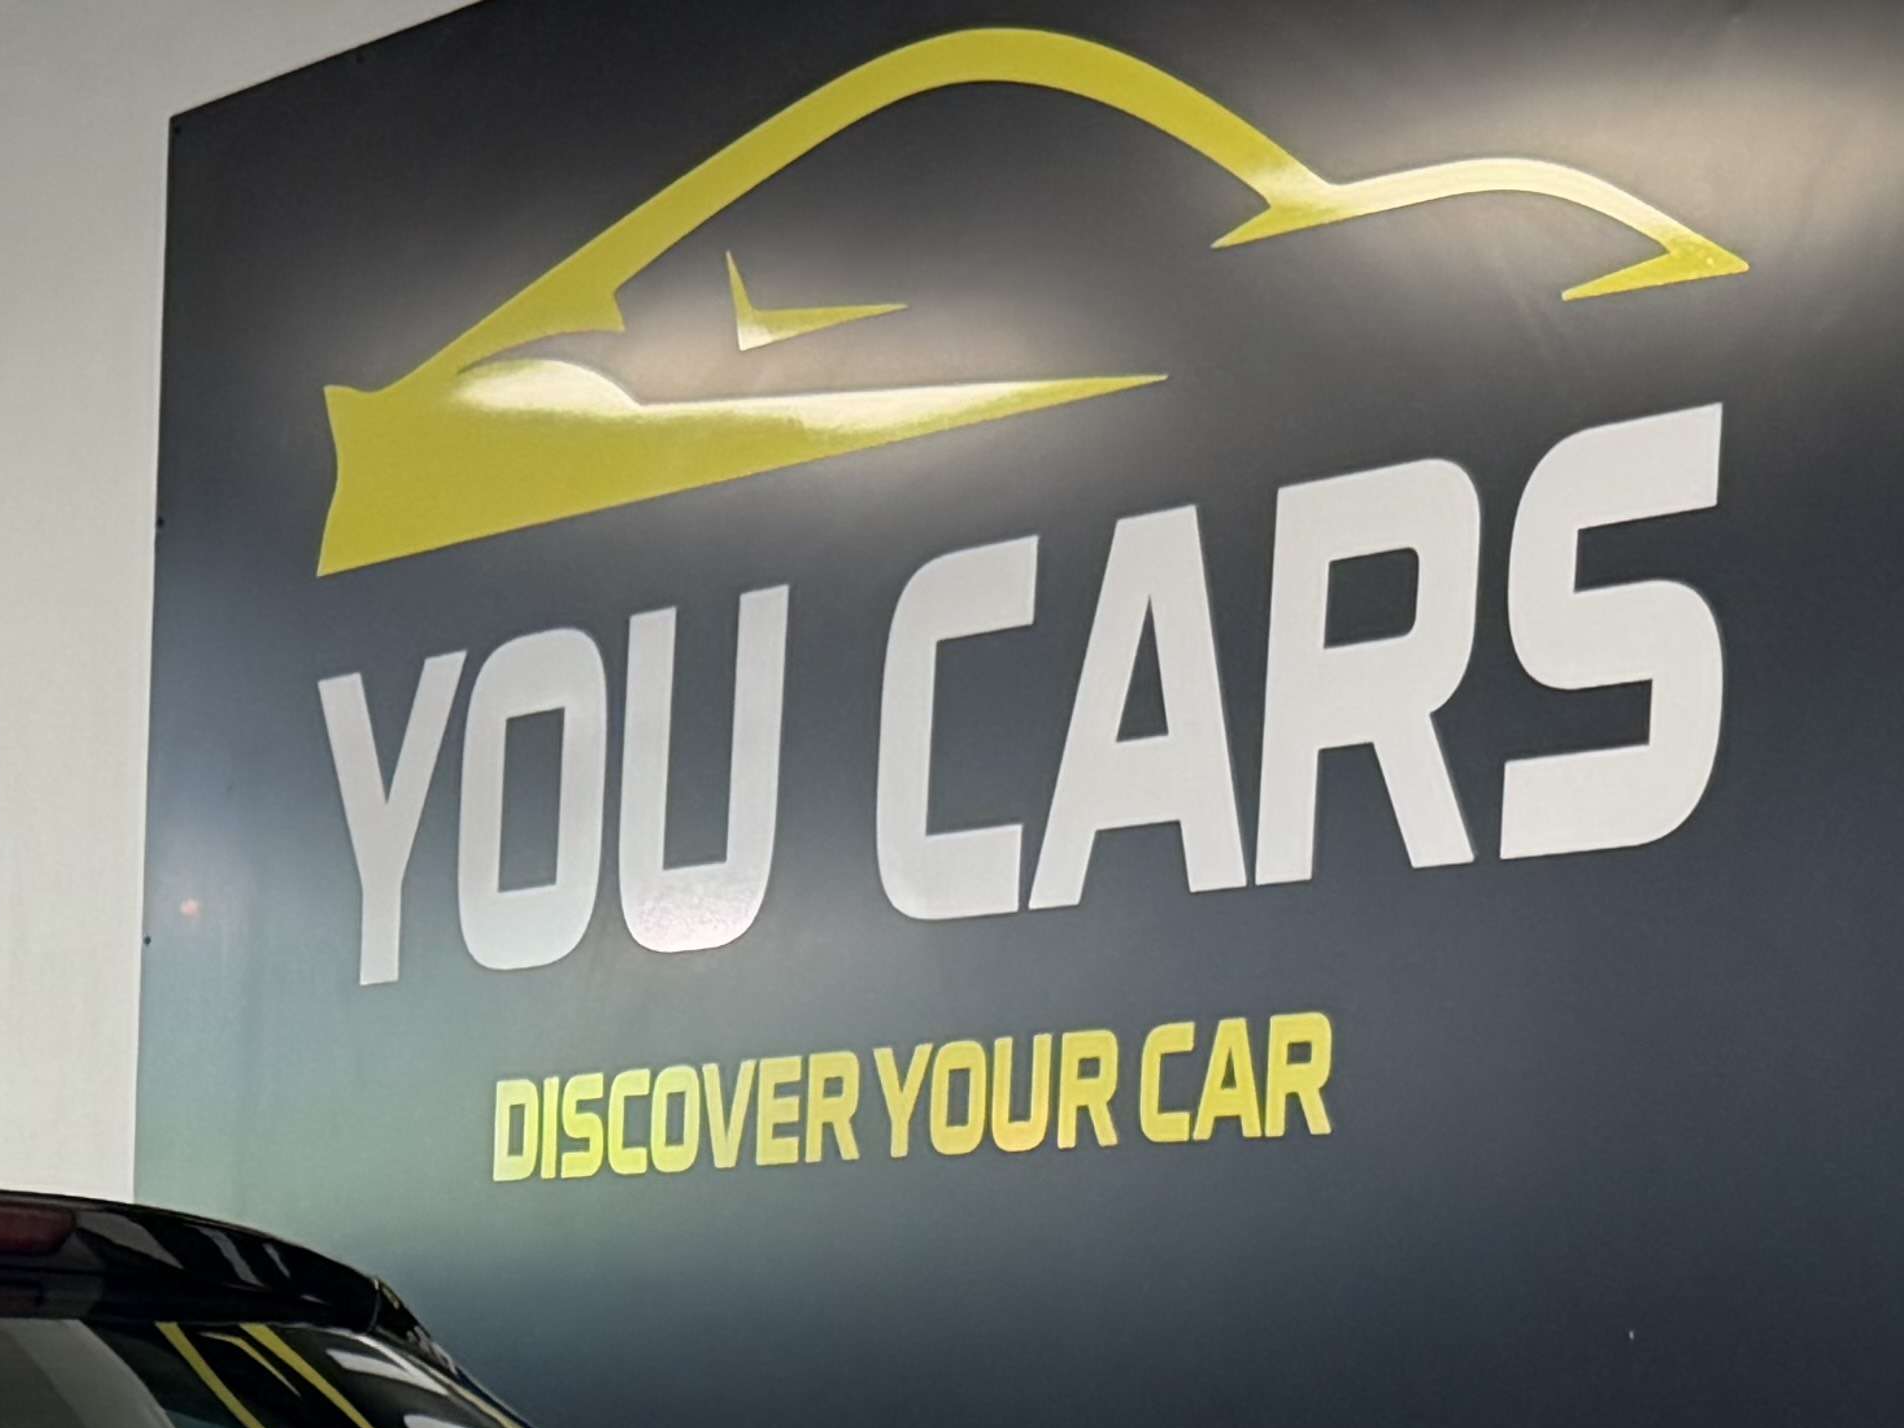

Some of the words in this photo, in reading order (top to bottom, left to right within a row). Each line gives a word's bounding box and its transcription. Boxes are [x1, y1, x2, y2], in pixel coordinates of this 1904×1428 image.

[318, 584, 789, 987] YOU
[875, 402, 1722, 921] CARS
[493, 1051, 859, 1182] DISCOVER
[874, 1029, 1119, 1158] YOUR
[1139, 1011, 1332, 1143] CAR
